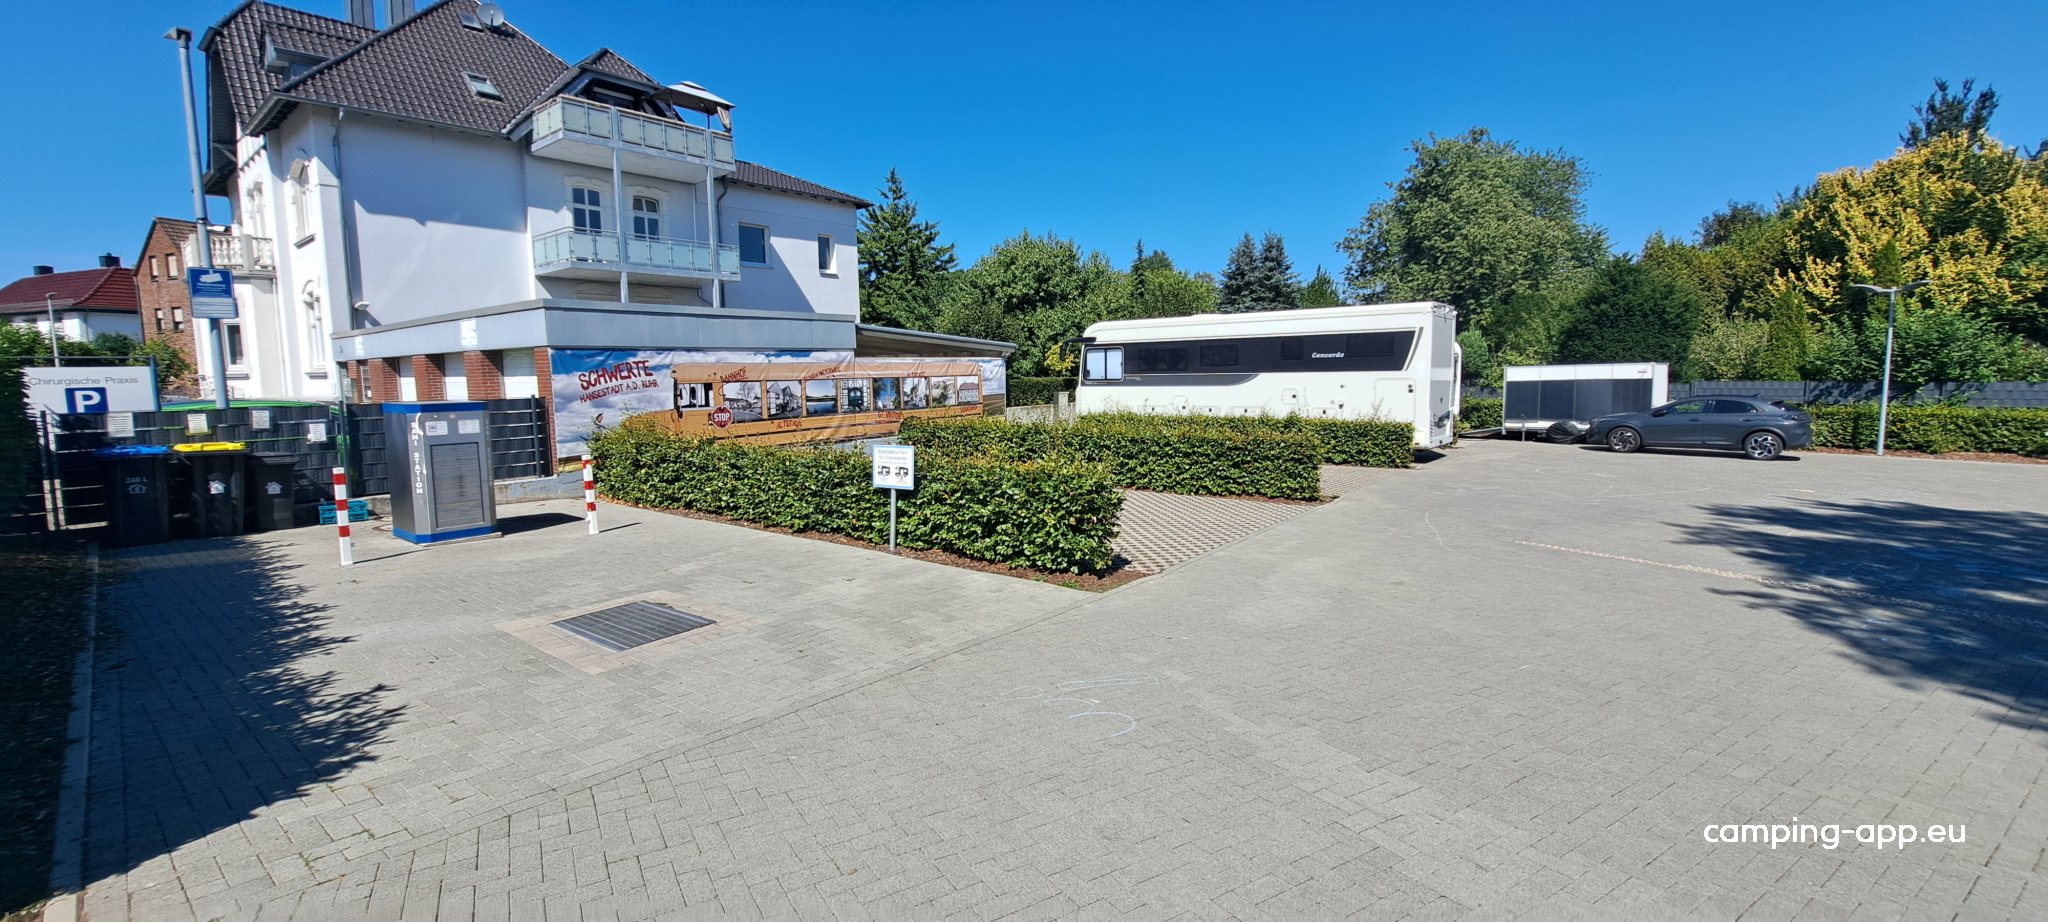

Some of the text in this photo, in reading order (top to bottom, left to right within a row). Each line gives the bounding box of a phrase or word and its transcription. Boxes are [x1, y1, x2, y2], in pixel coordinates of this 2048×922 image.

[1311, 351, 1345, 359] Concorde
[28, 376, 138, 387] Chirurgische Praxis
[578, 360, 654, 391] SCHWERTE
[719, 367, 747, 382] BAHNHOF
[580, 379, 660, 404] HANSESTADT A.D. RUHR
[74, 390, 101, 413] P
[713, 412, 731, 422] STOP
[413, 452, 424, 495] STATION
